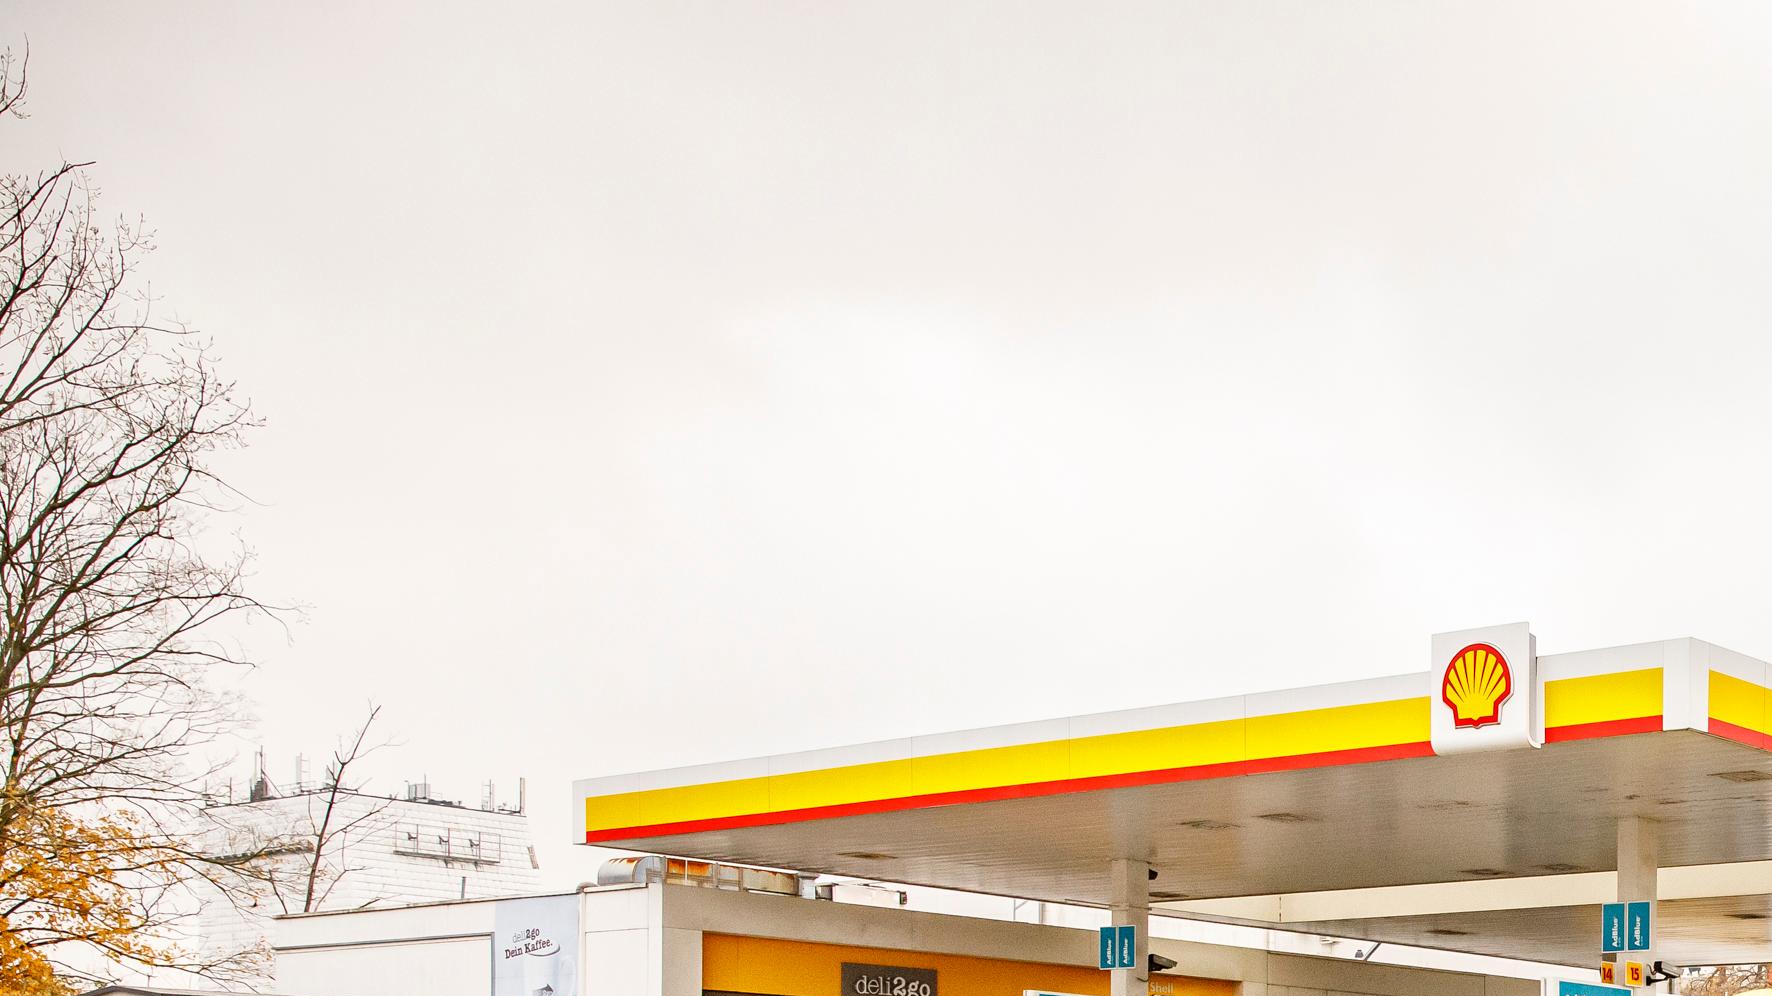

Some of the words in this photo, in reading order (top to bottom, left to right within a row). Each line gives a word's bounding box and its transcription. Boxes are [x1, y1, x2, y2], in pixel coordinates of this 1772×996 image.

[512, 928, 540, 943] deli2go
[504, 946, 523, 960] Dein
[524, 939, 553, 953] Kaffee.
[1602, 967, 1613, 981] 14
[1631, 968, 1640, 981] 15
[1150, 982, 1174, 993] Shell
